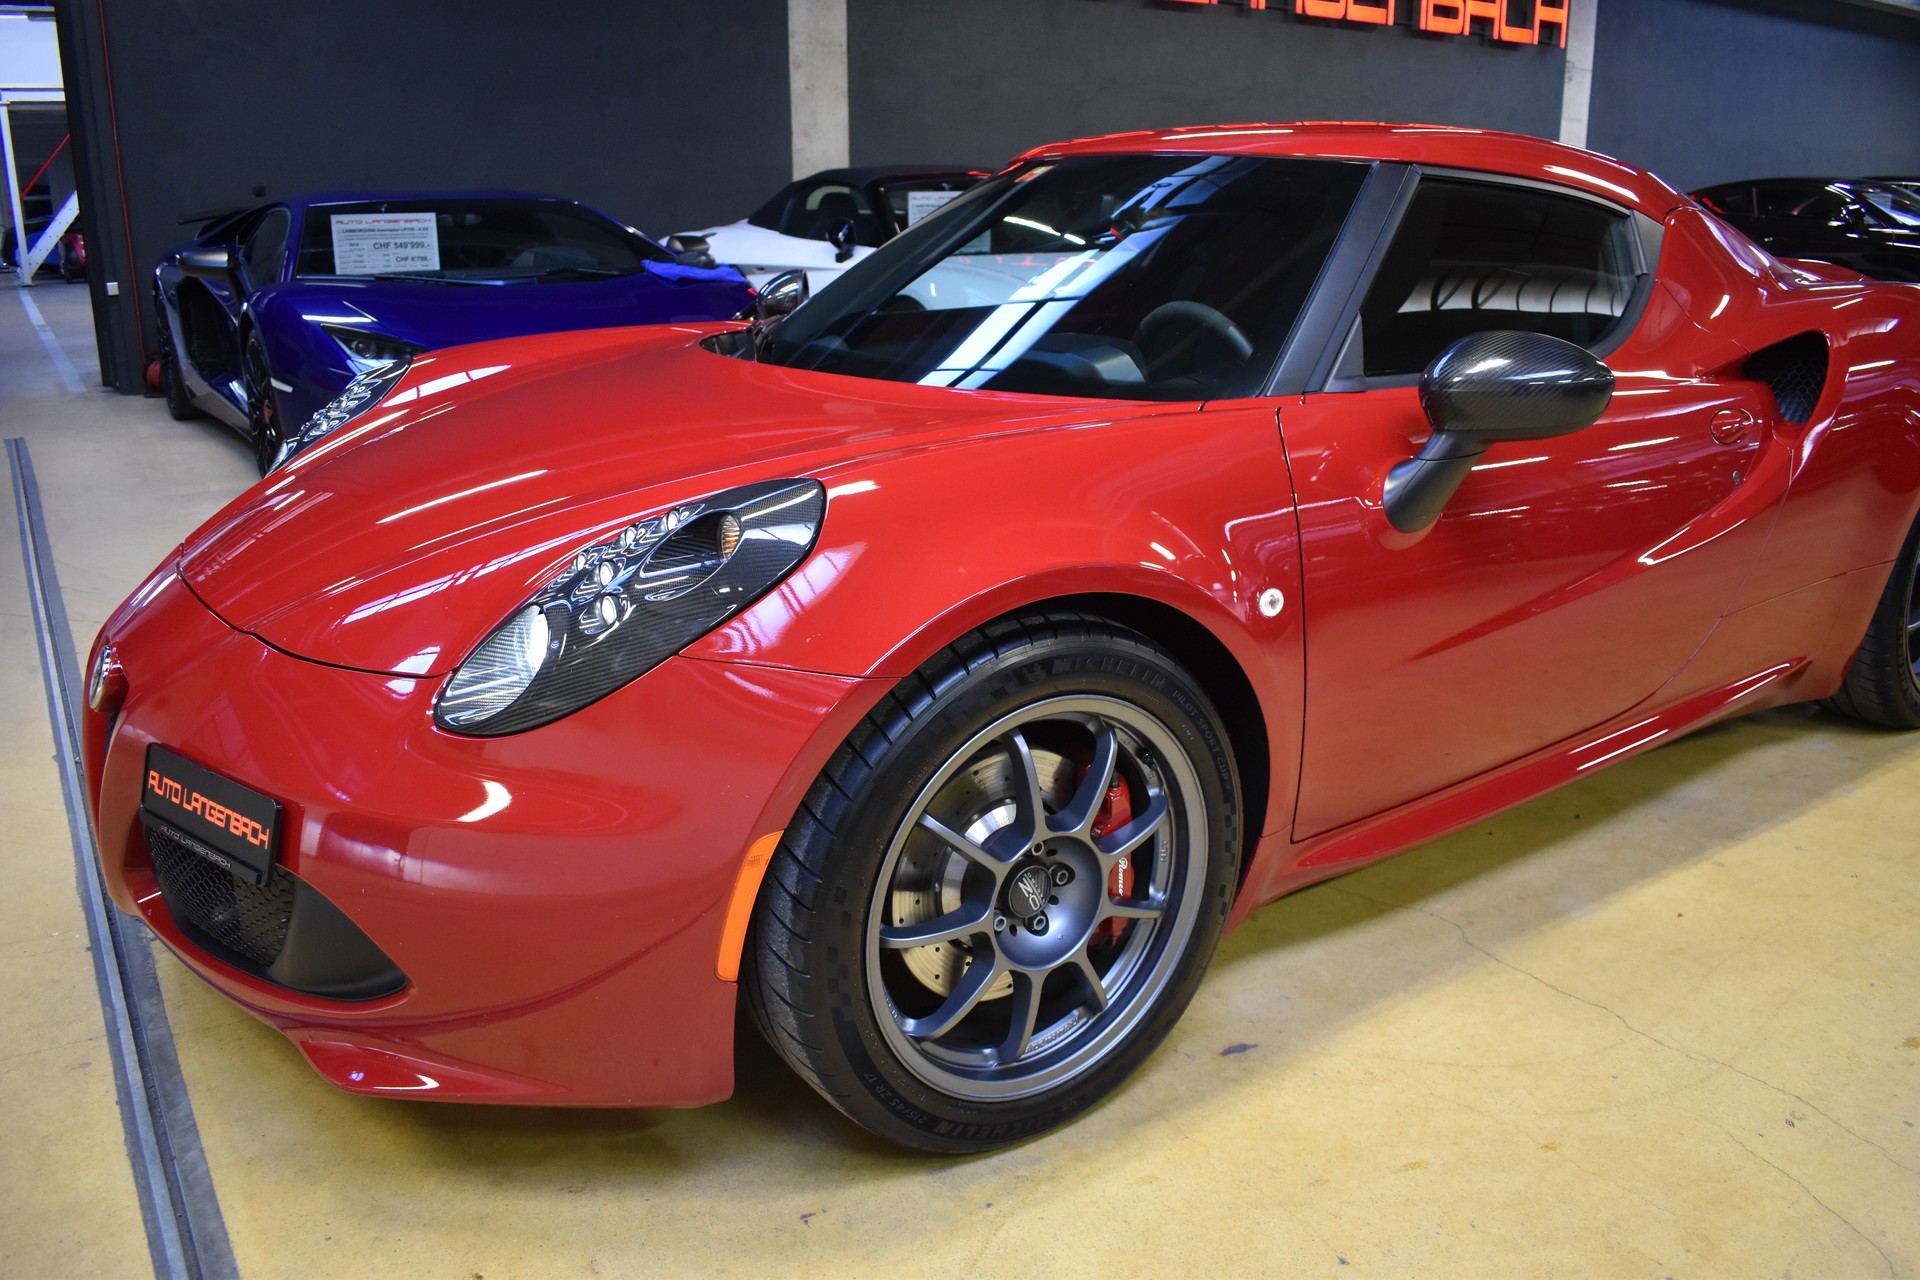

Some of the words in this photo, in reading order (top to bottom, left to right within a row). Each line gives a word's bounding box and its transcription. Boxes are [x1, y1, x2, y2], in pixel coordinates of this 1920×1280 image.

[373, 242, 391, 250] CHF
[1052, 656, 1167, 688] MICHELIN
[1172, 689, 1199, 717] PILOT
[1196, 717, 1220, 753] SPORT
[1216, 756, 1230, 780] CUP
[148, 769, 182, 804] AUTO
[183, 787, 270, 850] LANGENBACH
[161, 825, 180, 840] AUTO
[180, 836, 232, 868] LANGENBACH
[1118, 857, 1128, 896] Romeo
[863, 1073, 878, 1084] 17
[875, 1084, 893, 1100] ZR
[888, 1098, 929, 1124] 215/45
